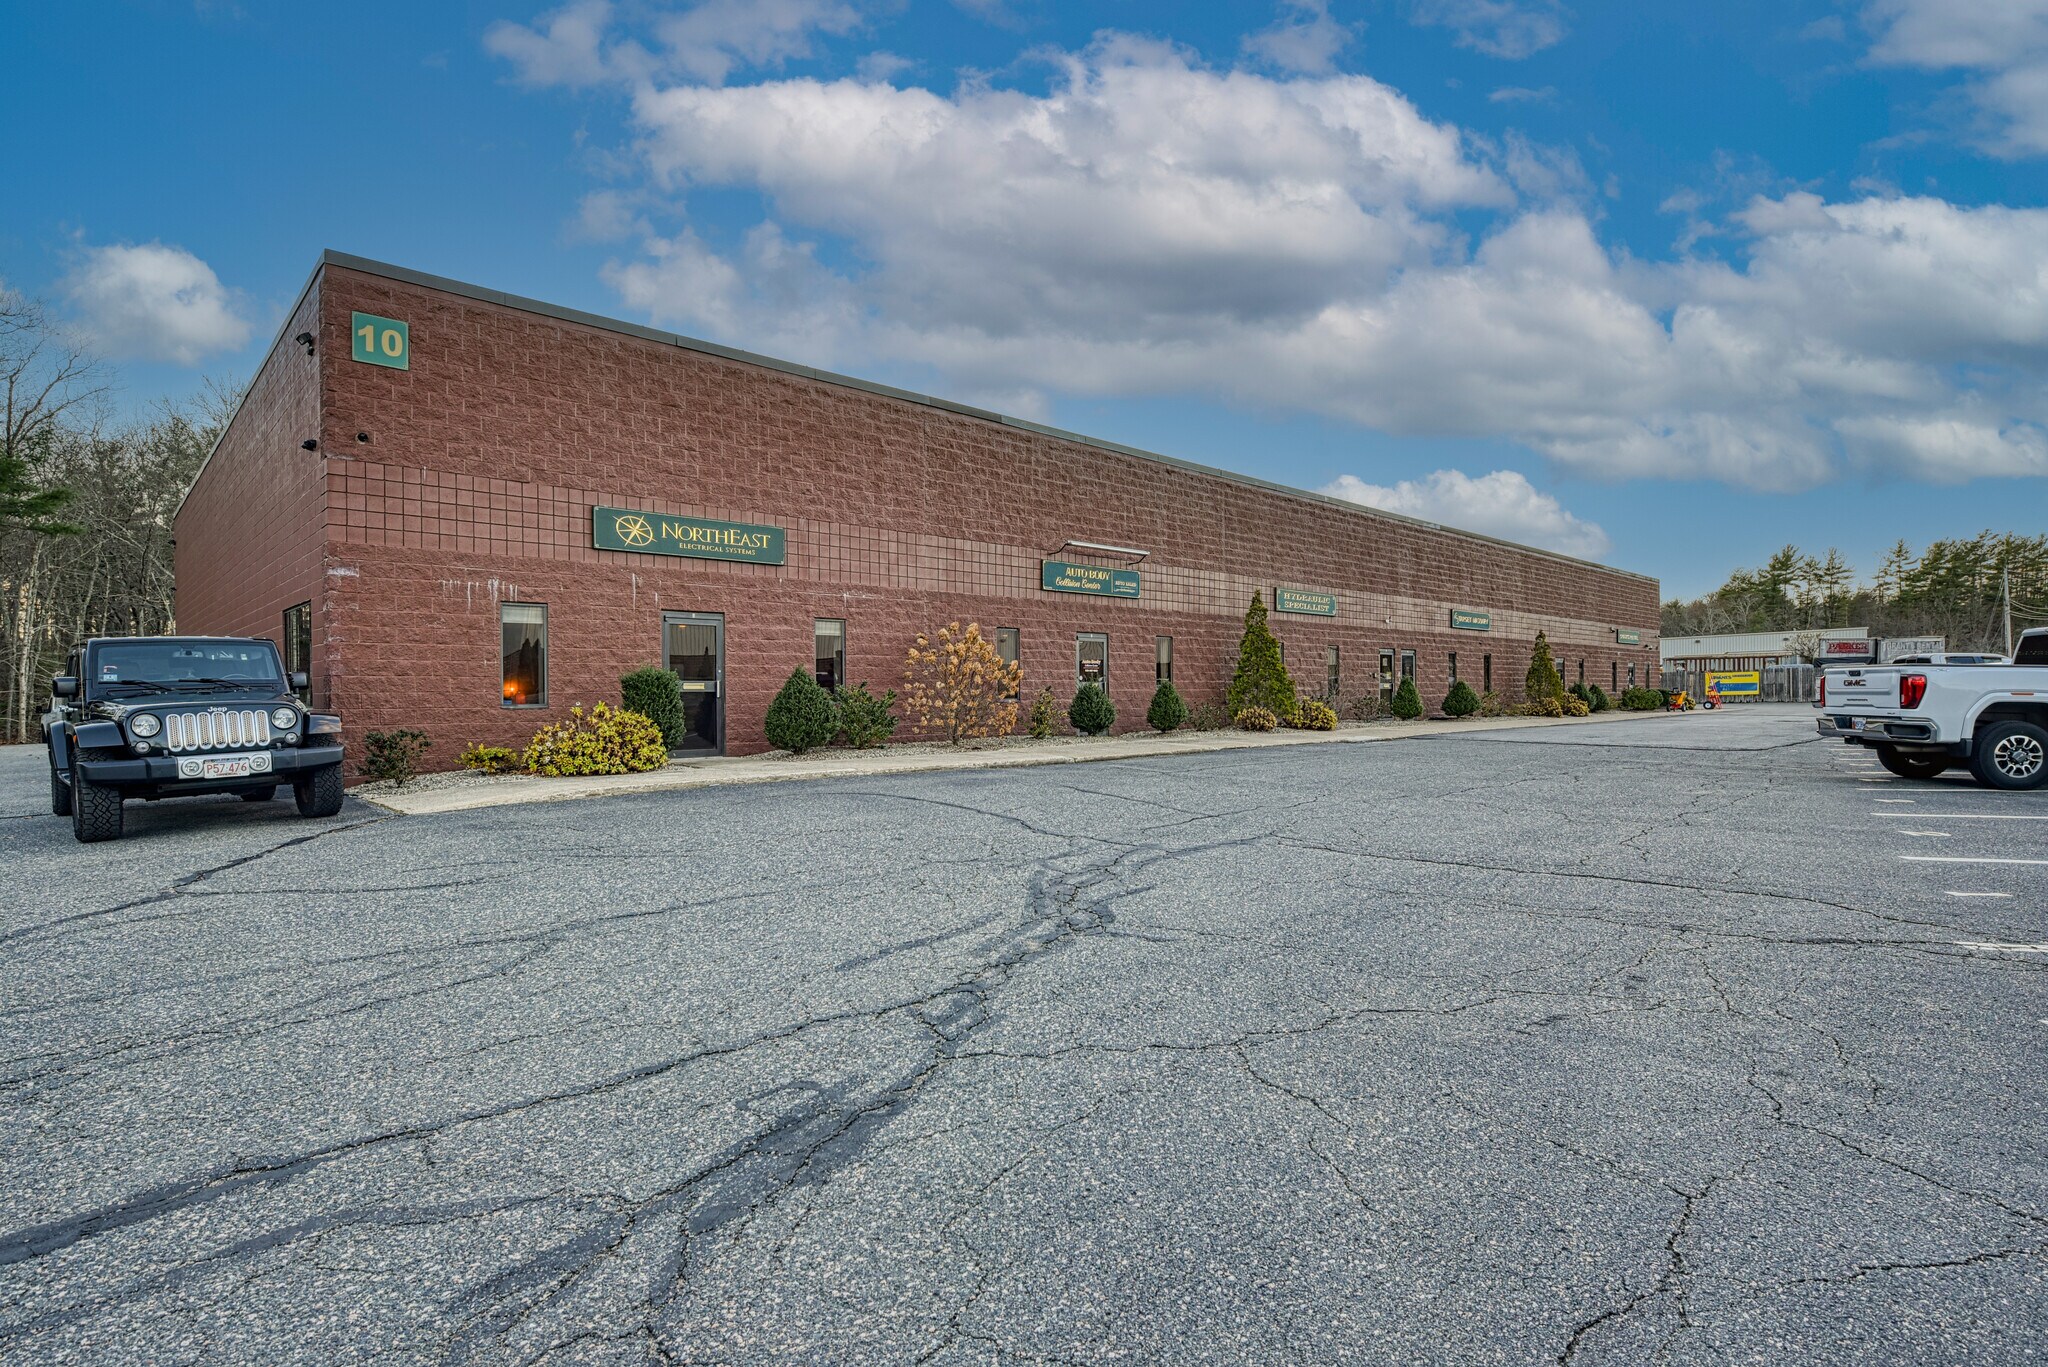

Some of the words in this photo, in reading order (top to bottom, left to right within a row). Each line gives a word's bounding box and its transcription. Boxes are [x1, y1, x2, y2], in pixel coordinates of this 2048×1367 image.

[357, 324, 403, 357] 10
[679, 542, 724, 553] ELECTRICAL
[725, 547, 756, 556] SYSTEMS
[1065, 567, 1088, 579] AUTO
[1089, 570, 1111, 580] BODY
[1055, 576, 1081, 588] Collision
[1081, 578, 1101, 590] Center
[1284, 600, 1330, 612] SPECIALIST
[1843, 679, 1867, 687] GMC
